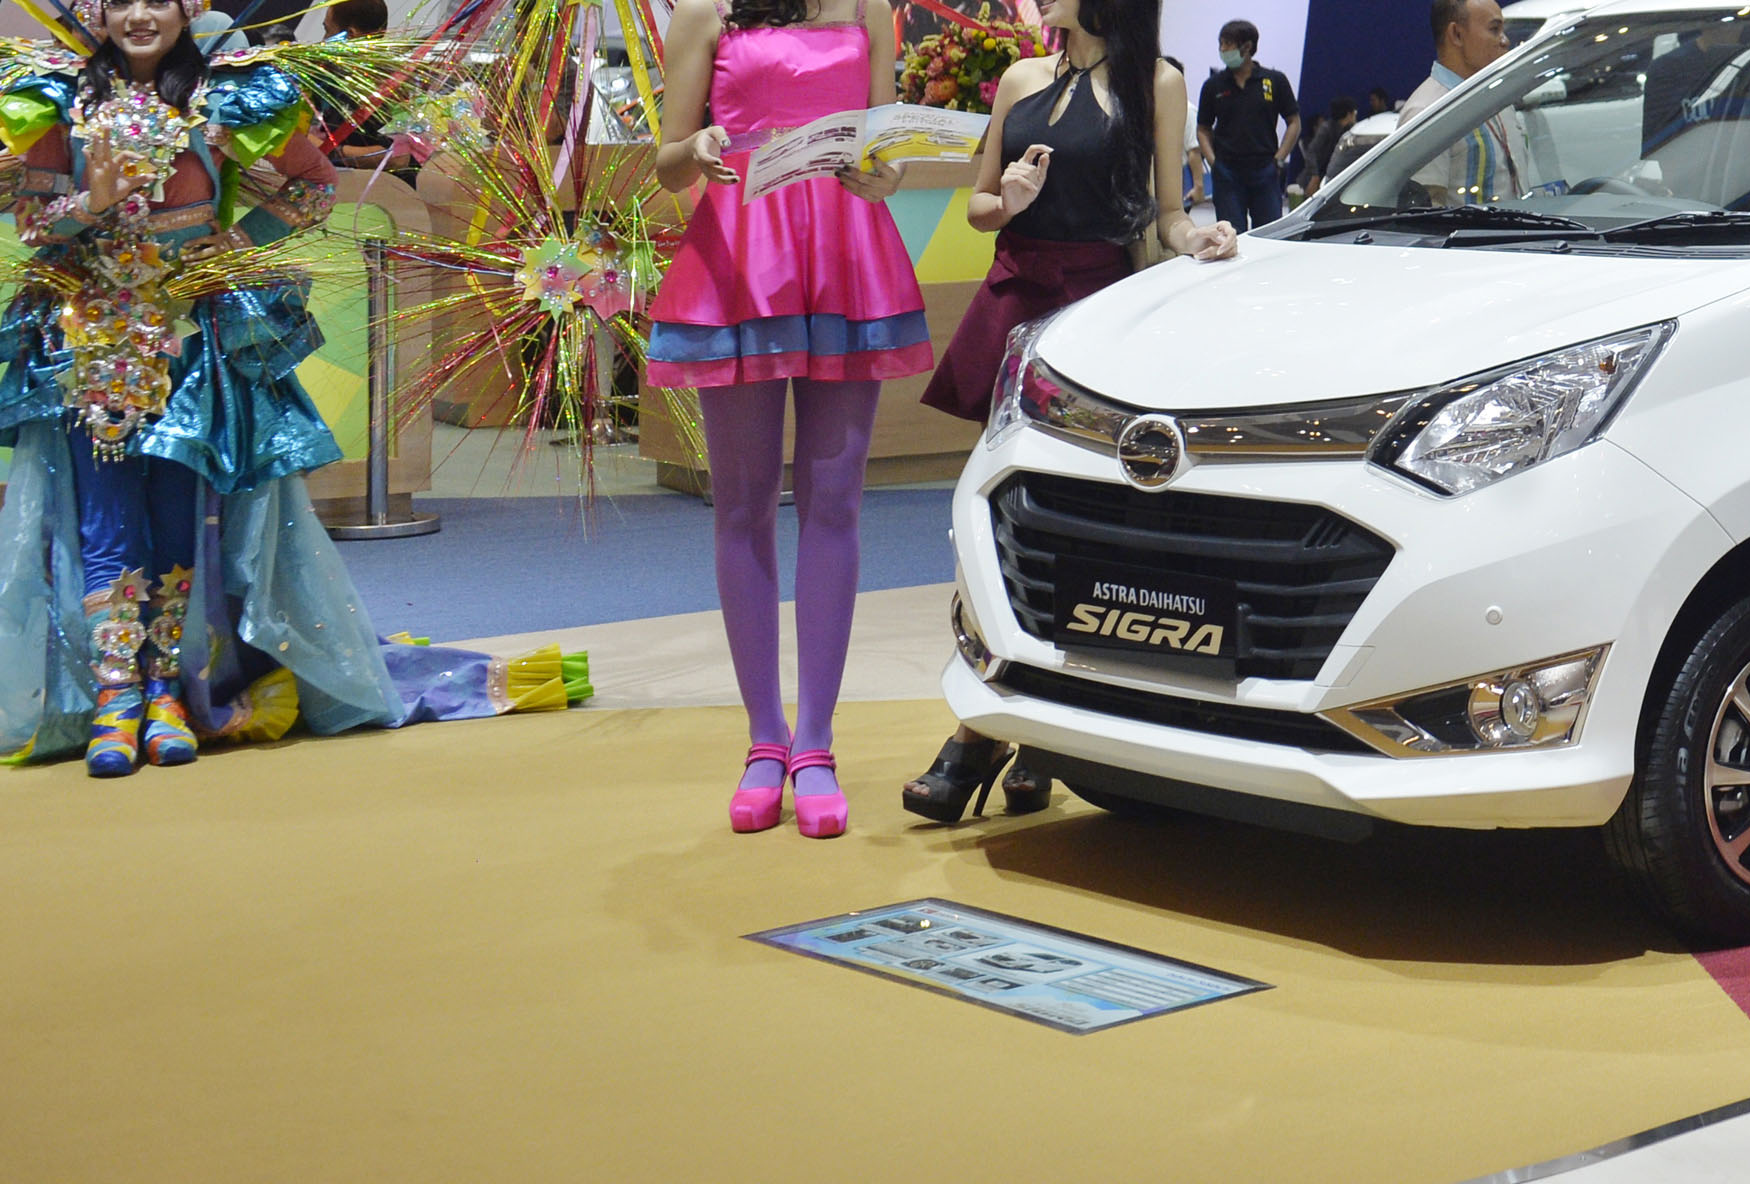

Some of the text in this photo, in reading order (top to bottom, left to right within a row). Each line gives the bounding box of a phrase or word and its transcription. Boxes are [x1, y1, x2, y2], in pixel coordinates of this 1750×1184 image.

[1092, 581, 1206, 616] ASTRA DAIHATSU
[1066, 603, 1224, 656] SIGRA
